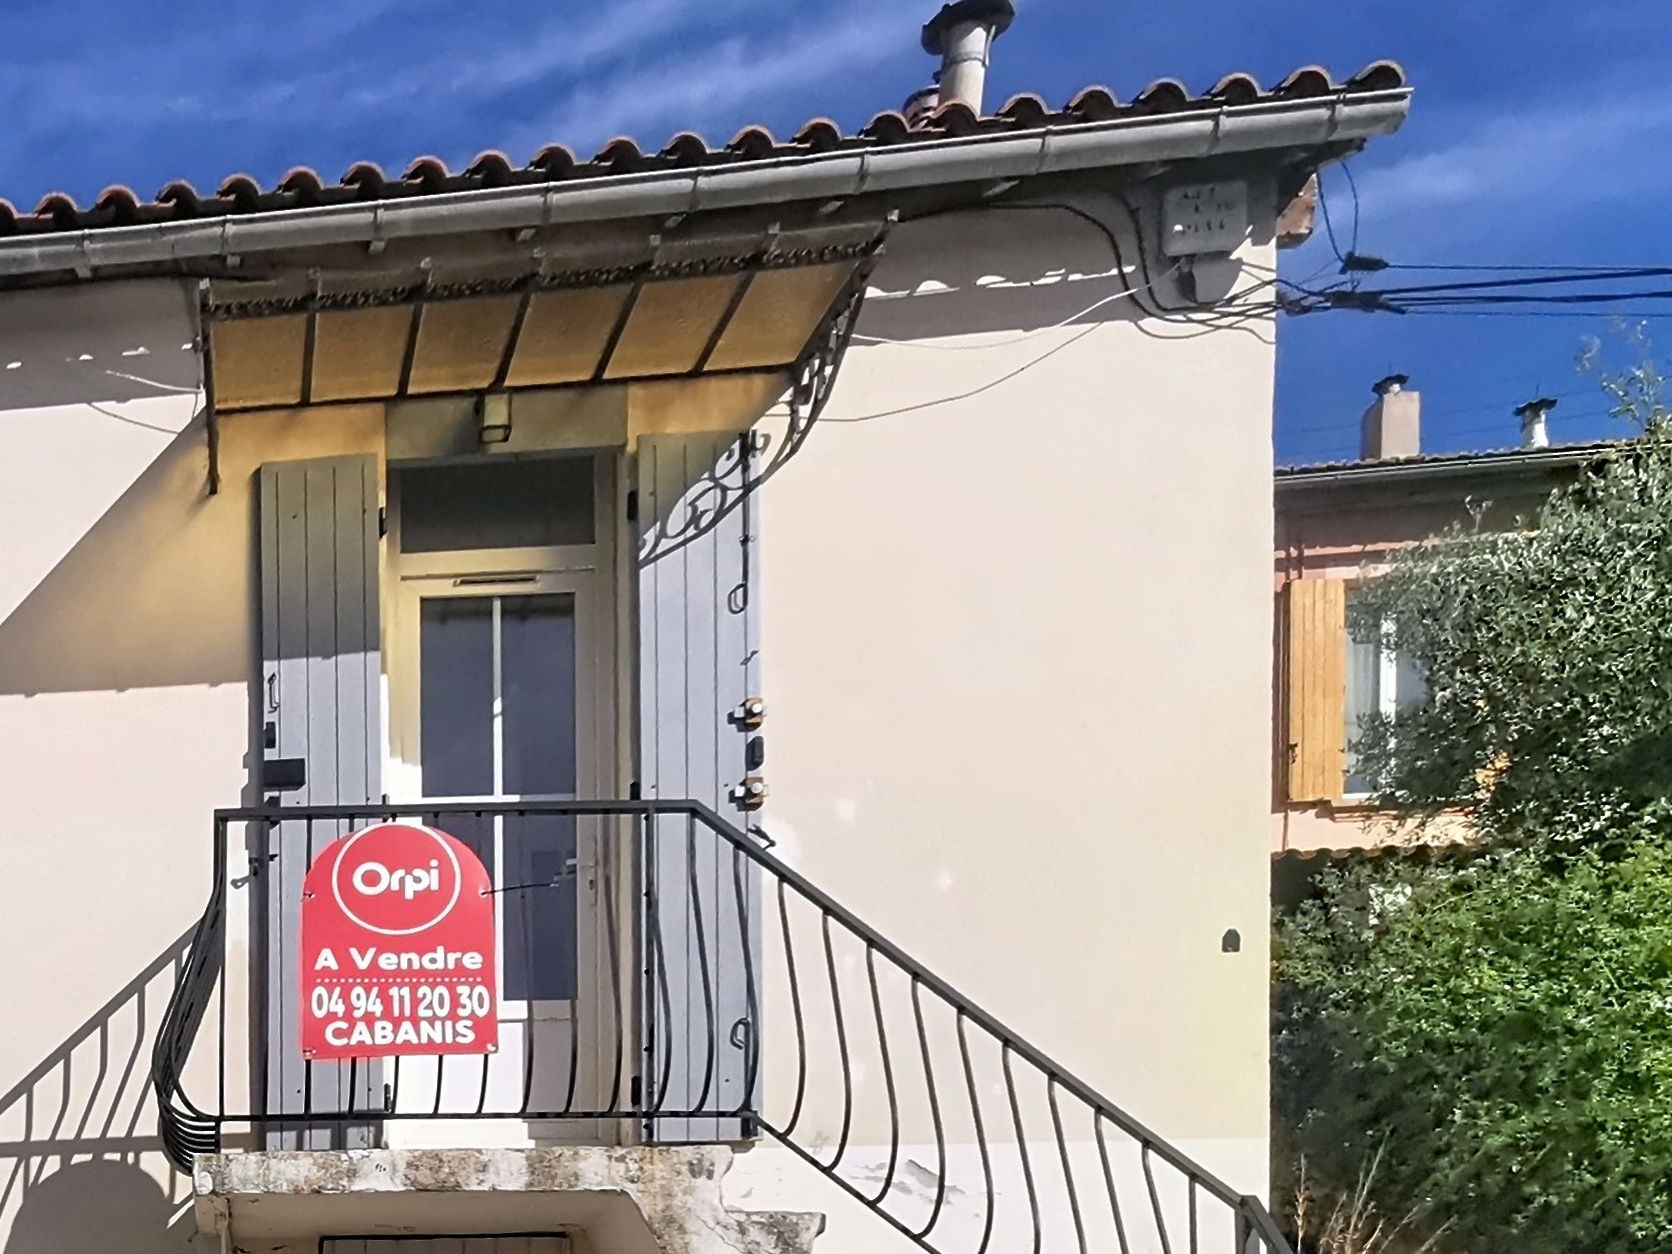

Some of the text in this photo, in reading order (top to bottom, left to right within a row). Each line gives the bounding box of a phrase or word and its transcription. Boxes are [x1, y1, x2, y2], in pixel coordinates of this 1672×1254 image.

[352, 859, 439, 899] Orpi
[314, 945, 483, 970] A Vendre
[311, 985, 490, 1018] 04 94 11 20 30
[324, 1020, 476, 1046] CABANIS
